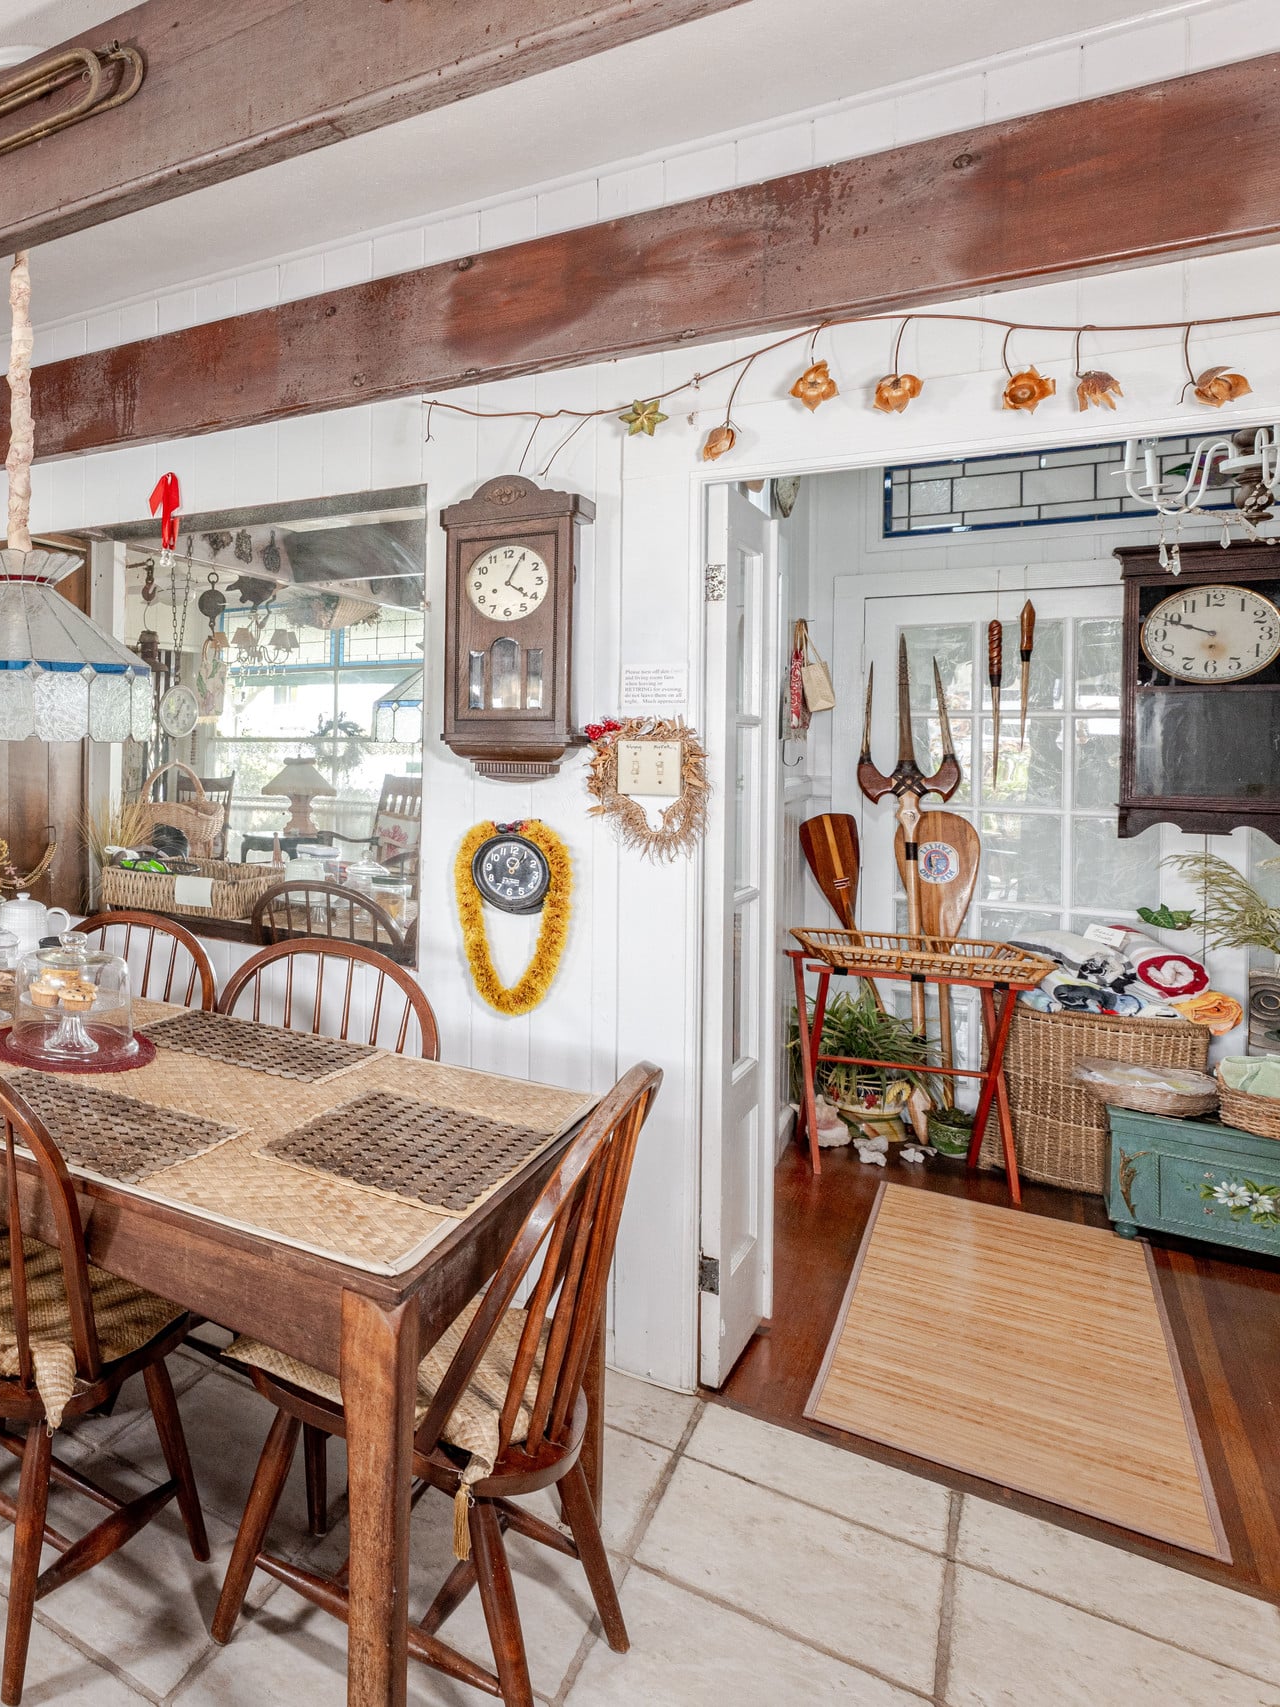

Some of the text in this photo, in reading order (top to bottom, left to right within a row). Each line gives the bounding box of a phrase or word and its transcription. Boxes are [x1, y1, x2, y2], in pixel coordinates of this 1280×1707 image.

[503, 549, 515, 559] 12
[488, 555, 497, 564] 11
[477, 566, 488, 575] 10
[531, 562, 539, 571] 2
[474, 581, 482, 590] 9
[535, 576, 544, 586] 3
[478, 595, 486, 604] 8
[529, 592, 539, 601] 4
[1206, 593, 1226, 607] 12
[489, 605, 497, 614] 7
[519, 603, 528, 612] 5
[1182, 600, 1196, 613] 11
[1240, 598, 1245, 612] 1
[503, 608, 512, 617] 6
[1253, 609, 1267, 624] 2
[1163, 612, 1182, 626] 10
[1154, 628, 1167, 642] 9
[1259, 626, 1273, 640] 3
[1161, 643, 1175, 657] 8
[1182, 656, 1195, 671] 7
[1204, 660, 1217, 674] 6
[1228, 656, 1242, 670] 5
[500, 847, 507, 856] 11
[510, 845, 519, 855] 12
[920, 843, 953, 855] TAHITI
[491, 852, 500, 862] 10
[486, 862, 493, 871] 9
[530, 860, 537, 868] 2
[488, 873, 495, 882] 8
[532, 871, 539, 880] 3
[496, 882, 502, 891] 7
[527, 881, 534, 890] 4
[506, 887, 513, 896] 6
[518, 887, 525, 896] 5
